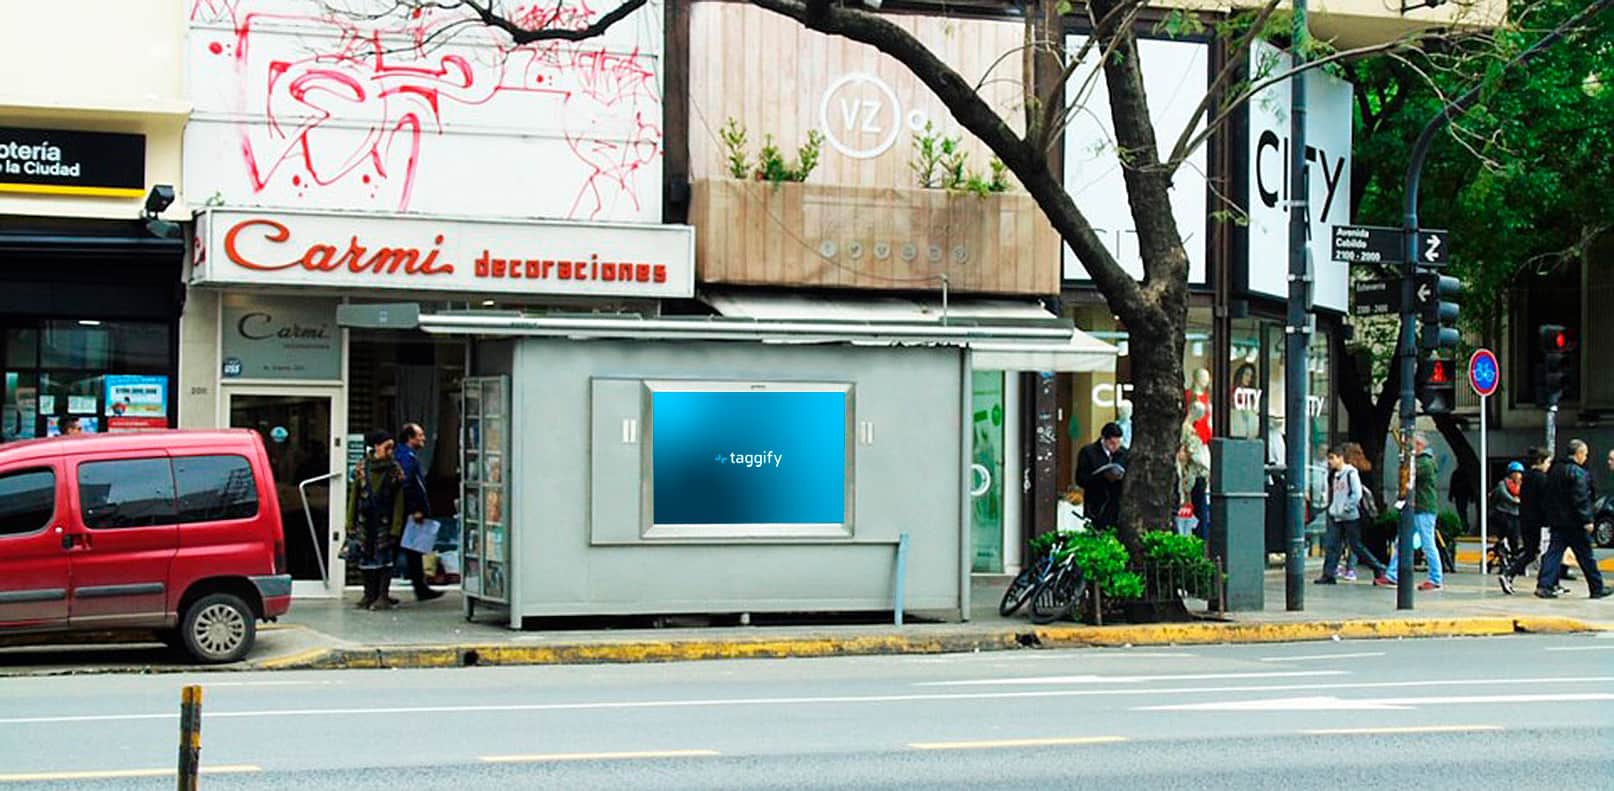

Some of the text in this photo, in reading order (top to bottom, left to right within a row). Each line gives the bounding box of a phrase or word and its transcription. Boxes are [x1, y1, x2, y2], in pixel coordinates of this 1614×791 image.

[841, 100, 881, 133] VZ
[5, 160, 20, 174] la
[23, 161, 80, 177] Ciudad
[1336, 228, 1370, 238] Avenida
[1336, 237, 1368, 249] Cabildo
[224, 219, 454, 275] Carmi
[475, 249, 666, 283] decoraciones
[238, 312, 330, 340] Carmi
[1234, 387, 1262, 411] CITY
[730, 450, 783, 468] taggify
